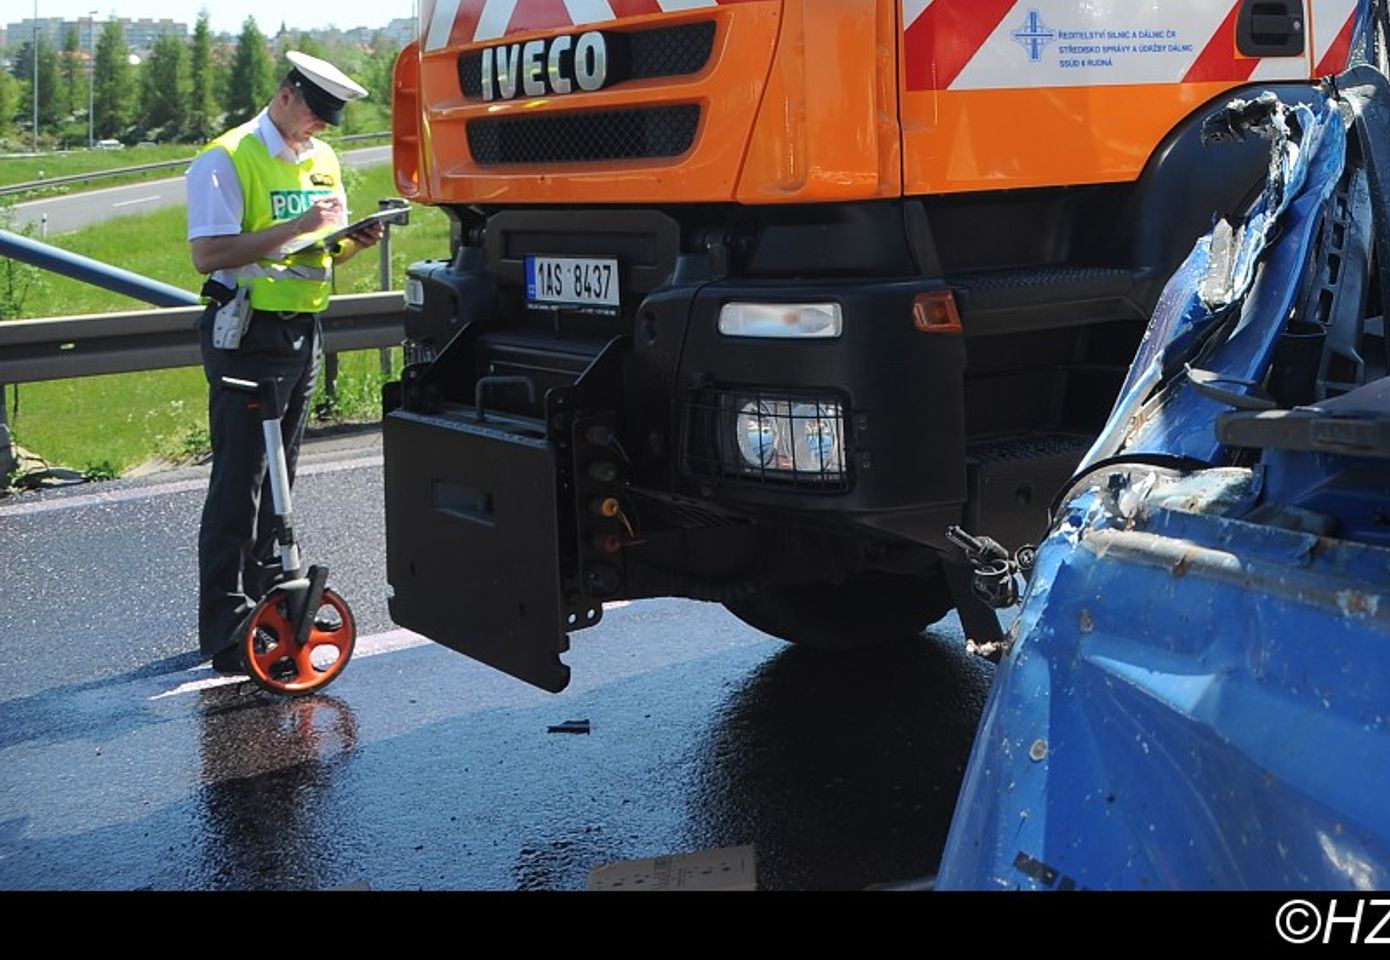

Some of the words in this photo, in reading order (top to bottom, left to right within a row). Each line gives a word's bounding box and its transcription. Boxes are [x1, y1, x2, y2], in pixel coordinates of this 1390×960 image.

[481, 31, 608, 101] IVECO
[538, 262, 562, 297] 1AS
[573, 263, 611, 299] 8437
